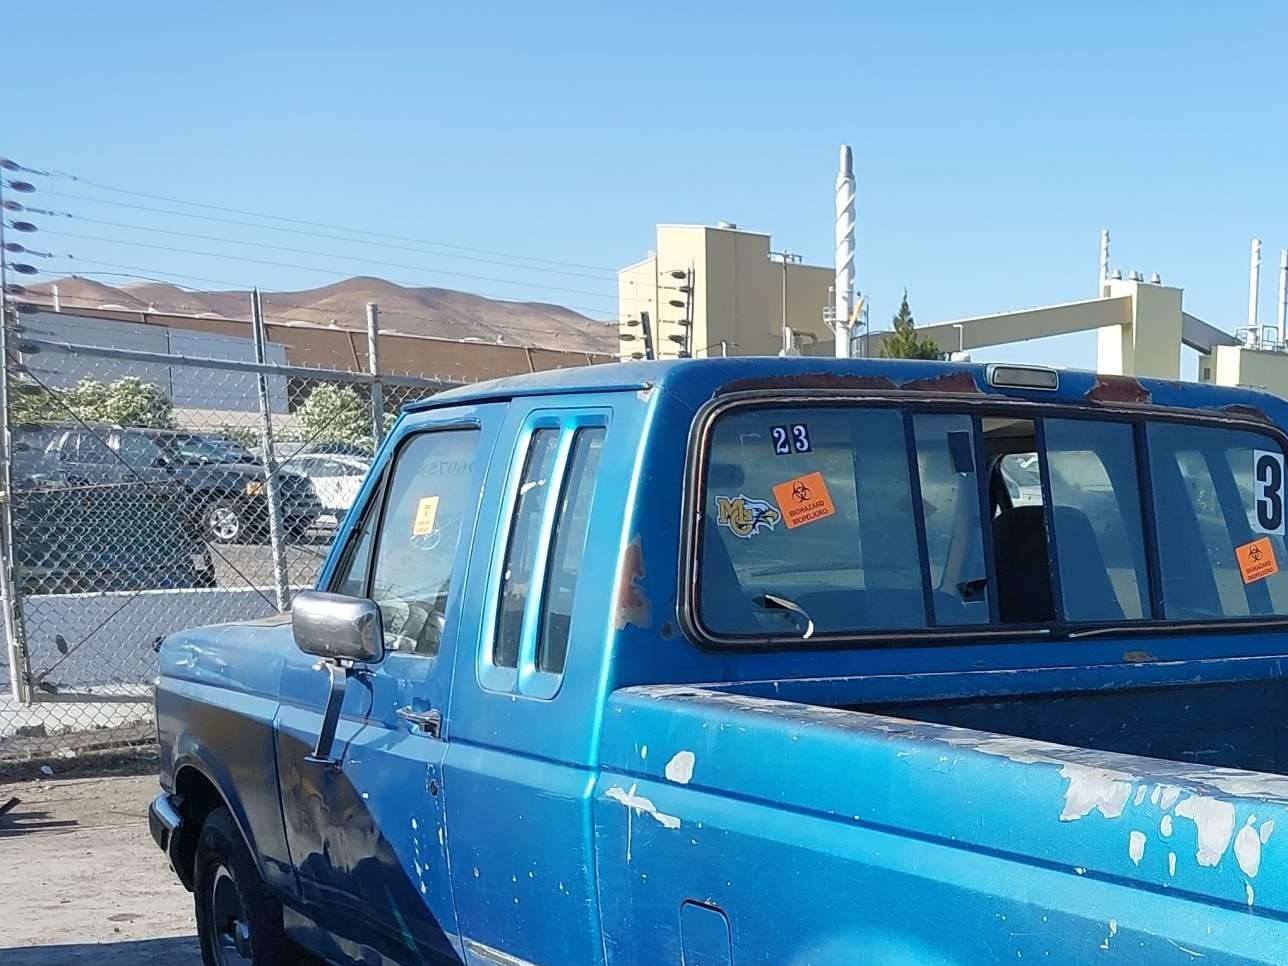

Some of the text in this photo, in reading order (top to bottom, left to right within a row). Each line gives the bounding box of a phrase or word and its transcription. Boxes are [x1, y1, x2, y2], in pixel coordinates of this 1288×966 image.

[773, 425, 809, 454] 23
[1256, 454, 1282, 531] 3
[788, 500, 825, 517] BIOHAZARD
[792, 508, 829, 525] BIOPELIGRO
